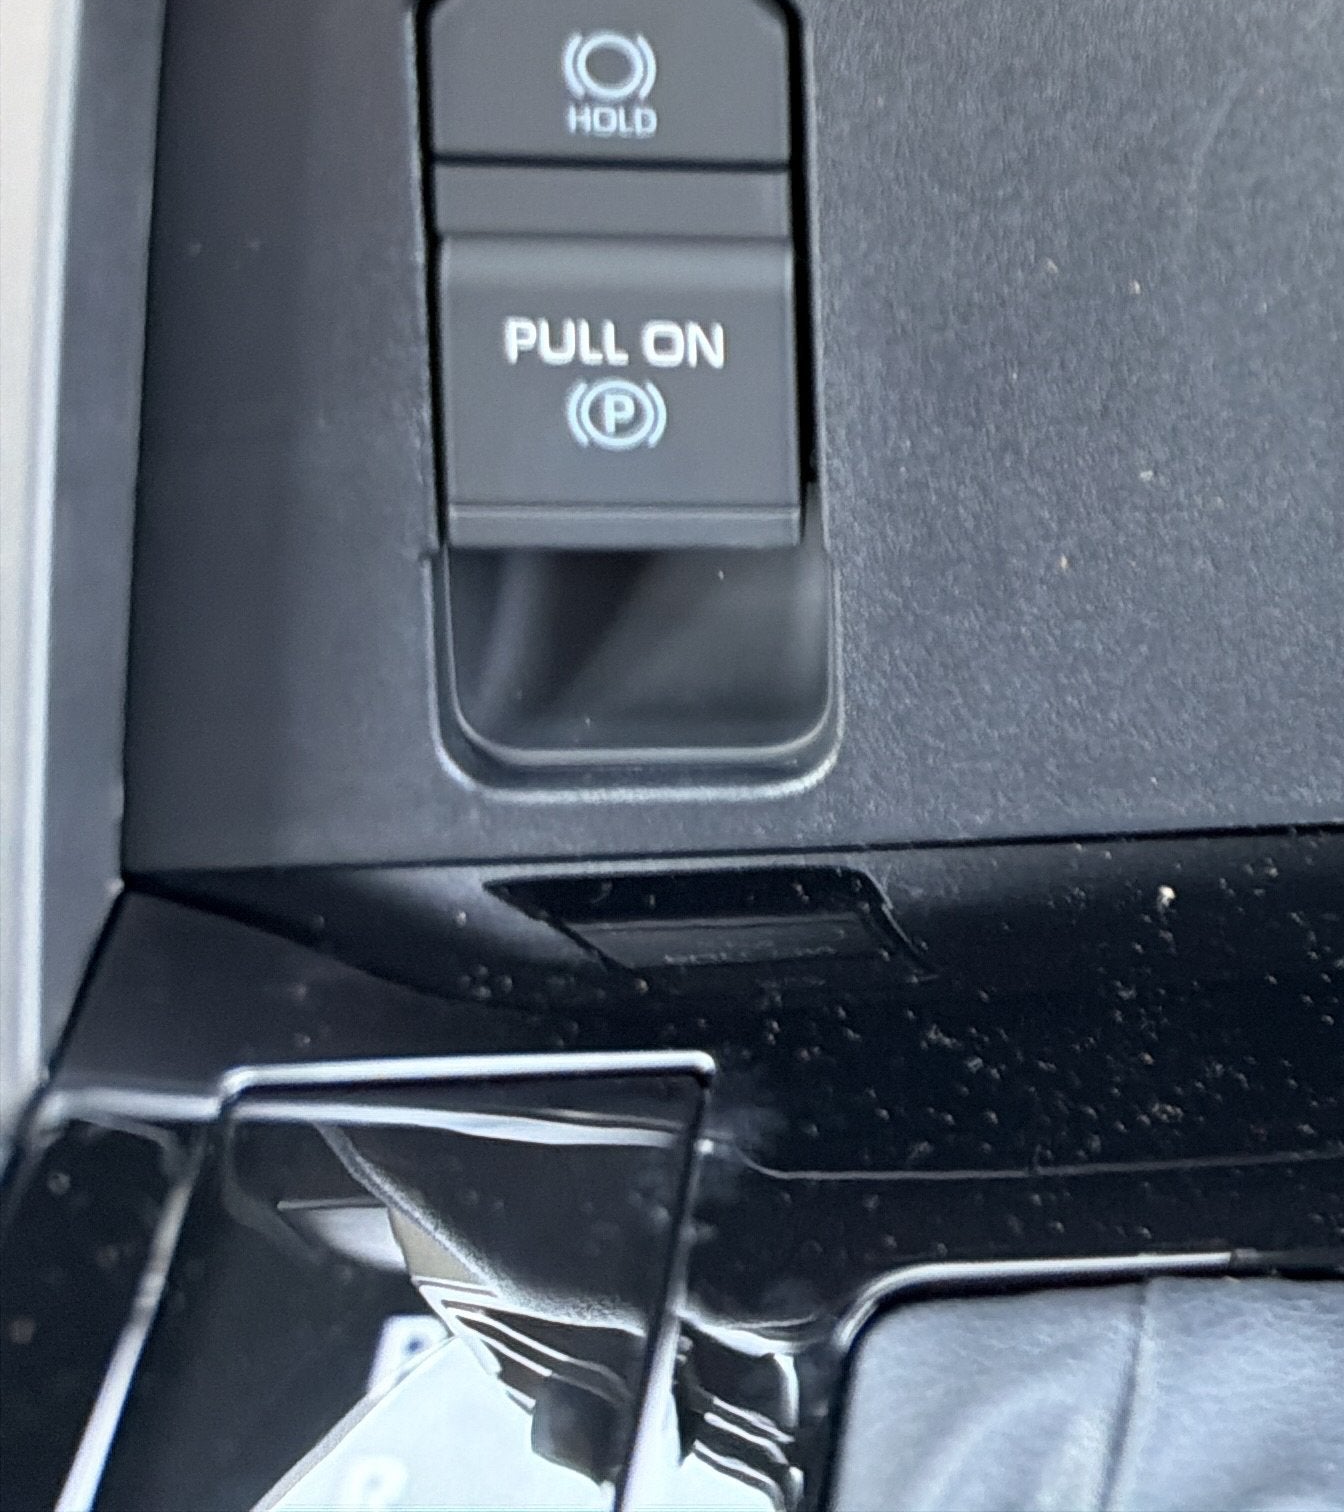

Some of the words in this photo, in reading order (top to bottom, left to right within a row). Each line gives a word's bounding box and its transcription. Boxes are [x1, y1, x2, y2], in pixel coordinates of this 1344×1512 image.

[566, 105, 658, 138] HOLD
[505, 317, 628, 366] PULL
[640, 320, 725, 369] ON
[602, 392, 634, 434] P
